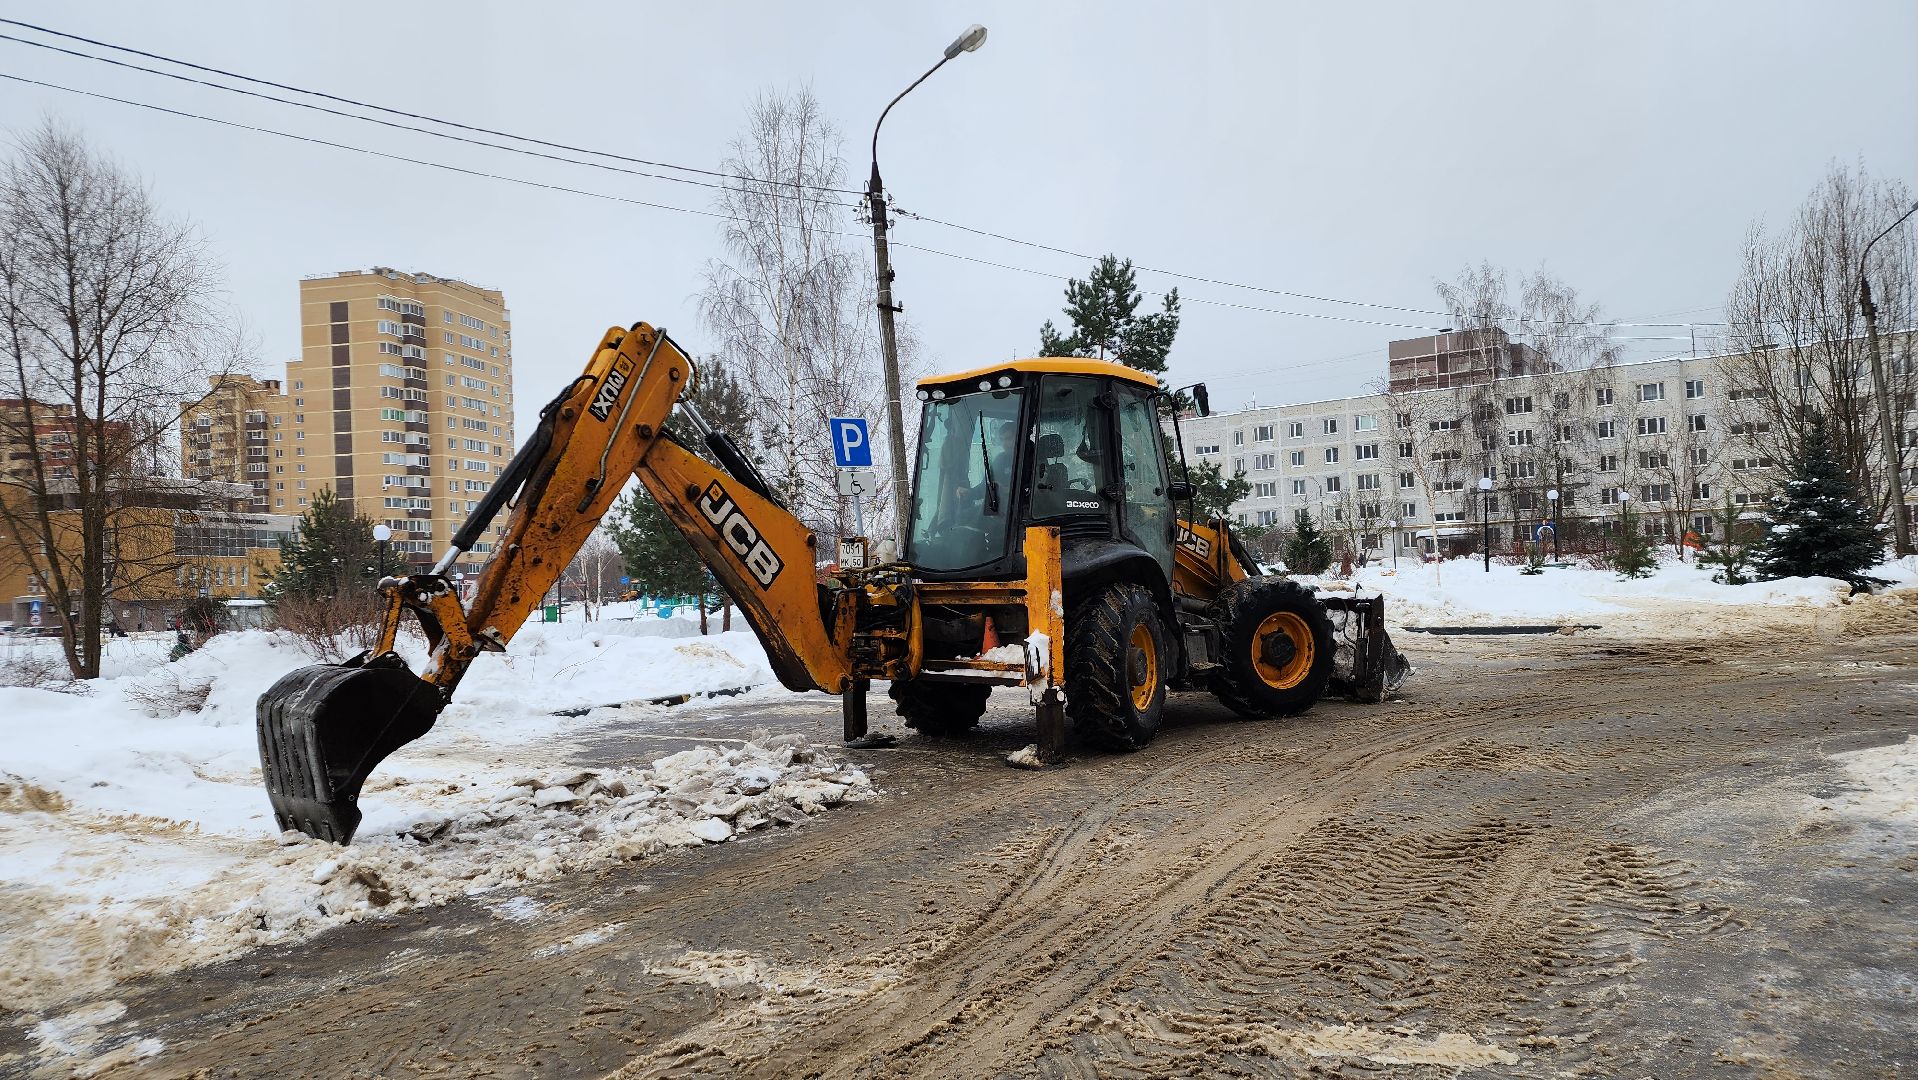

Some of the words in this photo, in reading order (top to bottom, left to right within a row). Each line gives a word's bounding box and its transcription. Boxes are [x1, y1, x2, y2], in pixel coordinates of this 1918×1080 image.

[841, 422, 863, 462] P
[700, 495, 780, 585] JCB
[852, 558, 862, 567] 50
